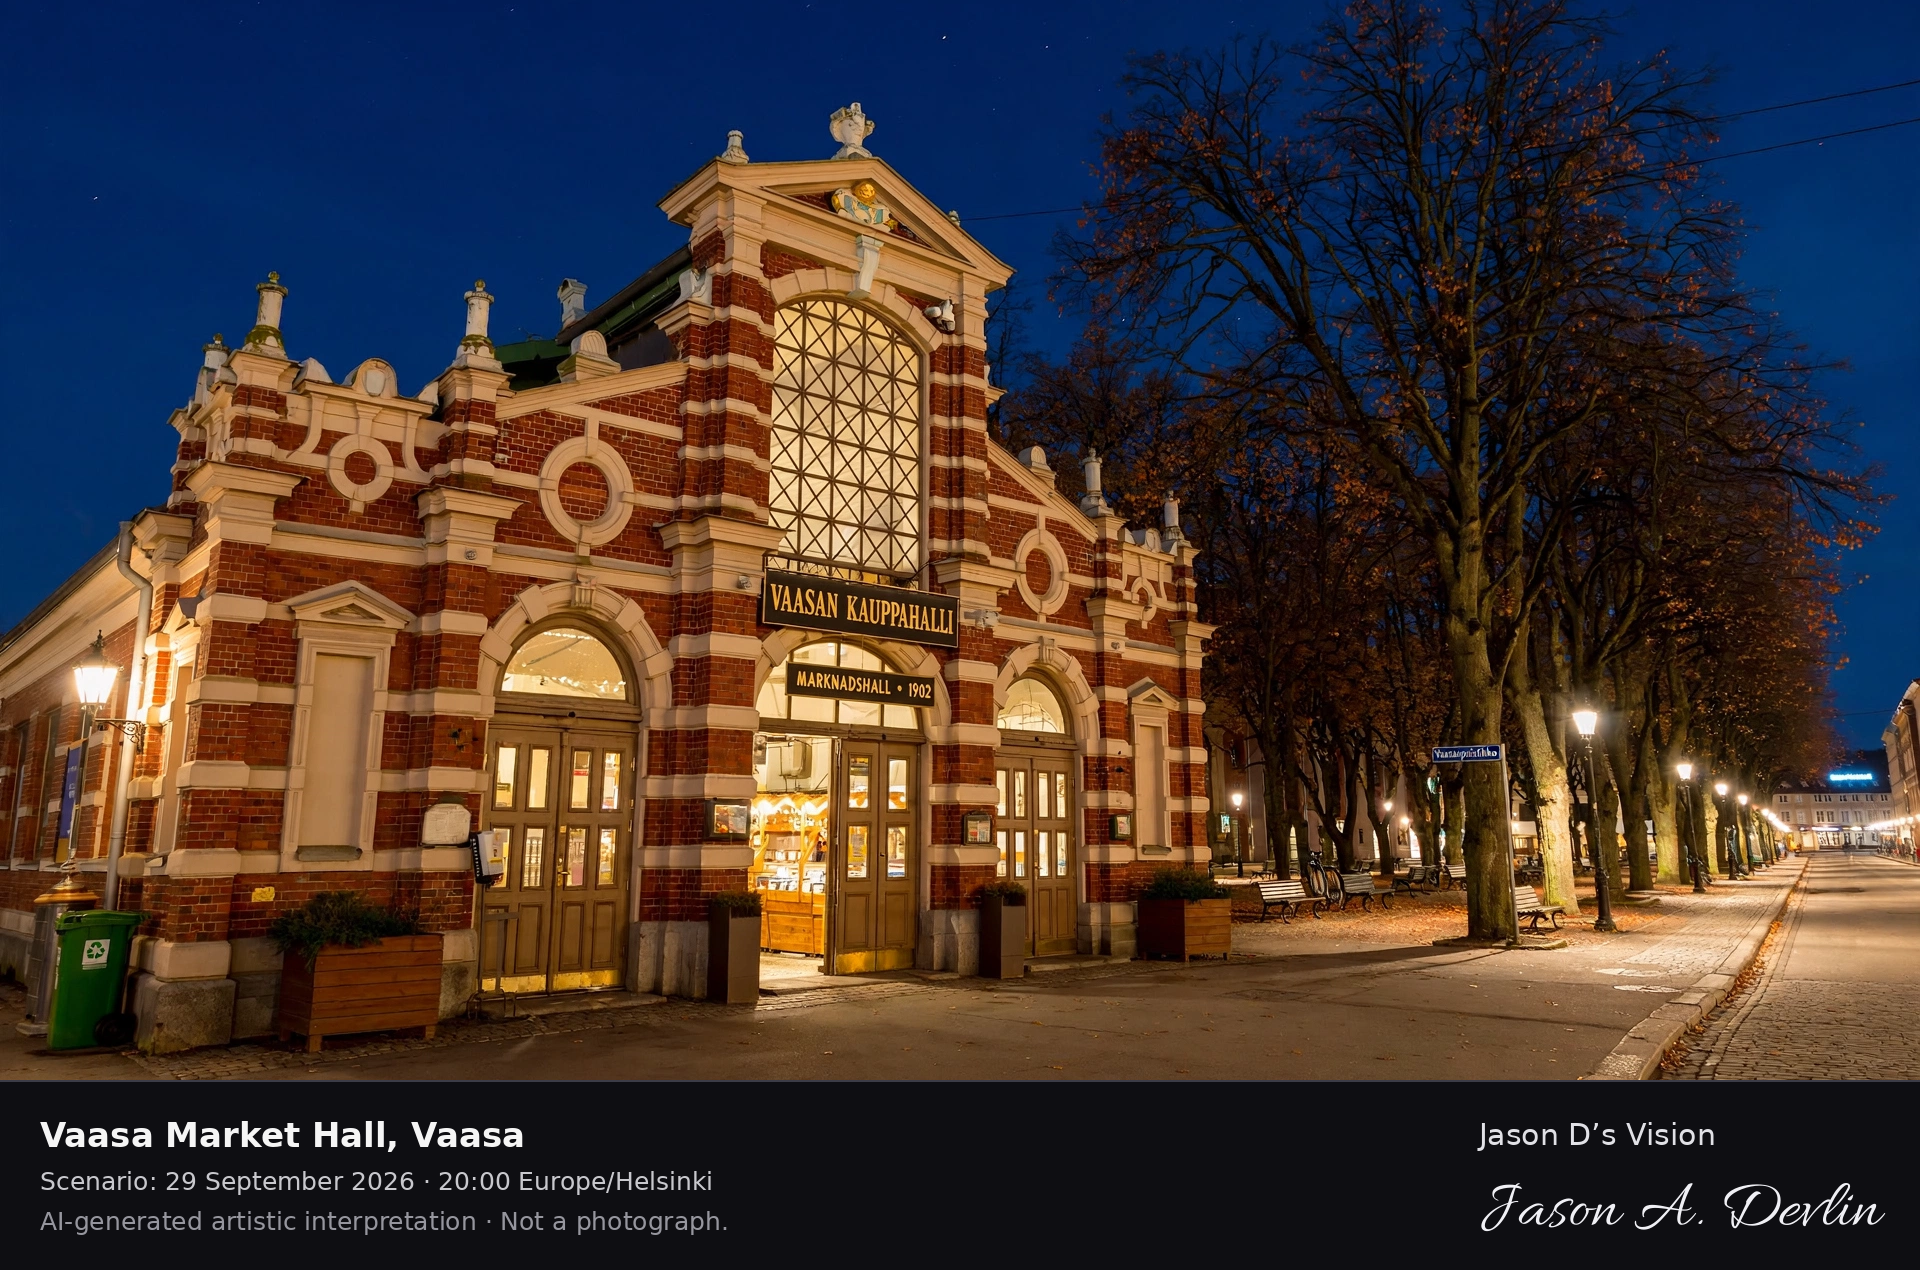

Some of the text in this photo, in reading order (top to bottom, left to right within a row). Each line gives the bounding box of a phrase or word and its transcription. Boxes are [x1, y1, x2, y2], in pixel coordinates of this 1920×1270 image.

[770, 583, 954, 635] VAASAN KAUPPAHALLI
[796, 670, 932, 699] MARKNADSHALL 1902
